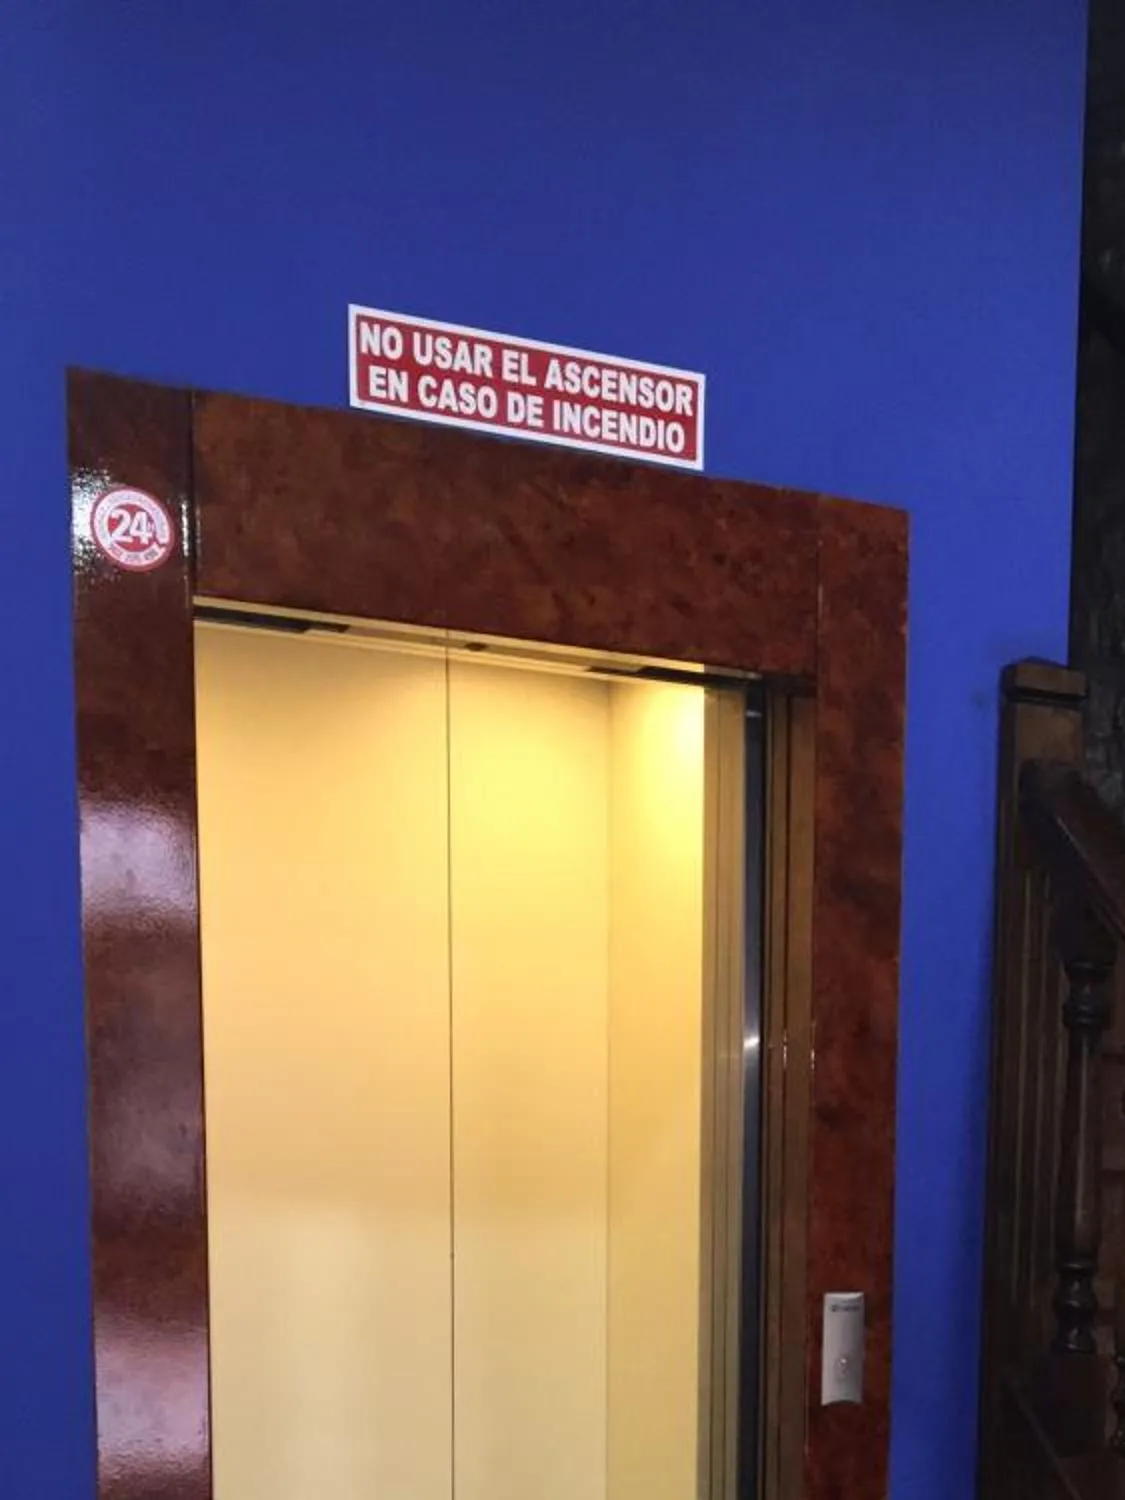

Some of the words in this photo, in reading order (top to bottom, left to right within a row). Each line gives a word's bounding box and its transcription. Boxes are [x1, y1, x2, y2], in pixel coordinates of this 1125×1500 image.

[359, 322, 402, 360] NO
[413, 332, 493, 378] USAR
[502, 349, 537, 386] EL
[544, 359, 693, 416] ASCENSOR
[368, 365, 409, 402] EN
[417, 375, 498, 420] CASO
[507, 391, 544, 427] DE
[552, 399, 685, 454] INCENDIO
